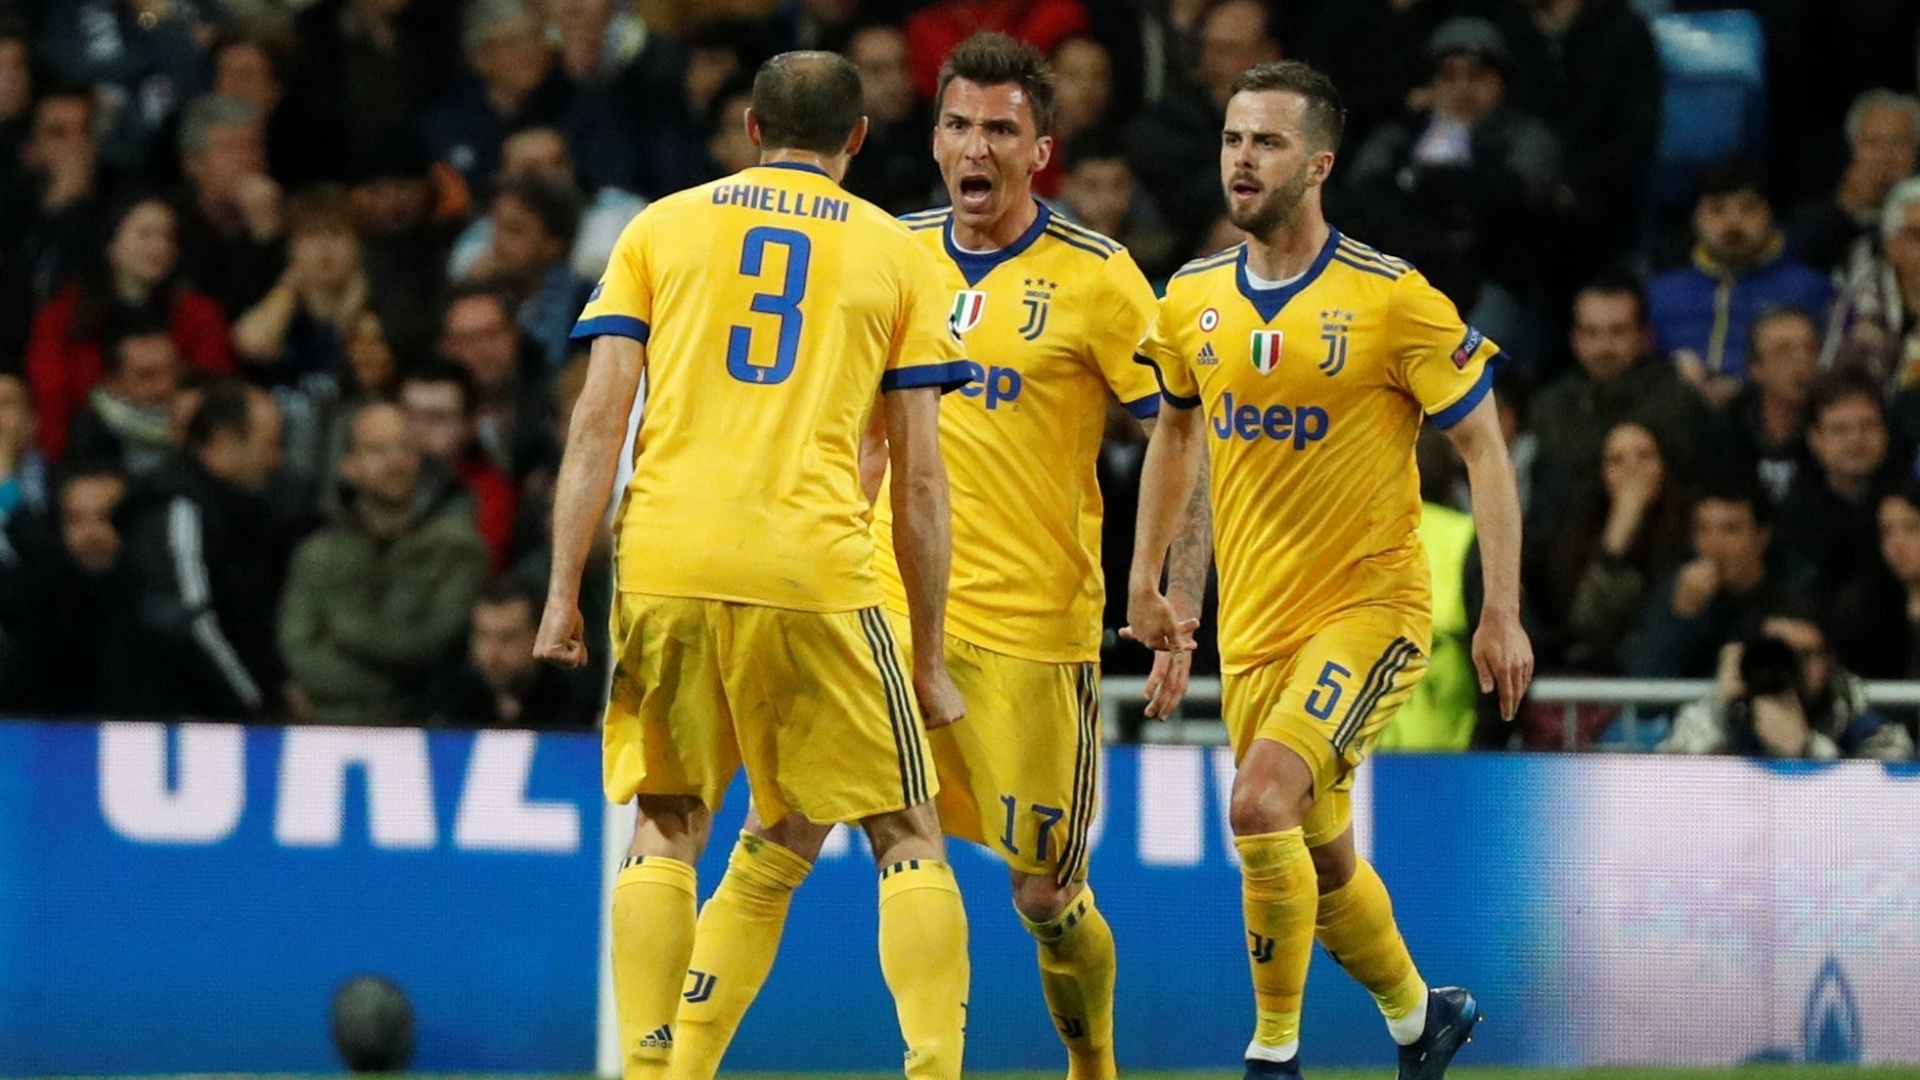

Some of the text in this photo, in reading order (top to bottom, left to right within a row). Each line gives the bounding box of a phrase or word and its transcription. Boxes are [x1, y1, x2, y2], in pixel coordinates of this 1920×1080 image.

[712, 184, 849, 222] CHIELLINI
[726, 226, 811, 385] 3
[1213, 392, 1329, 451] Jeep
[1304, 660, 1352, 720] 5
[1000, 795, 1063, 861] 17
